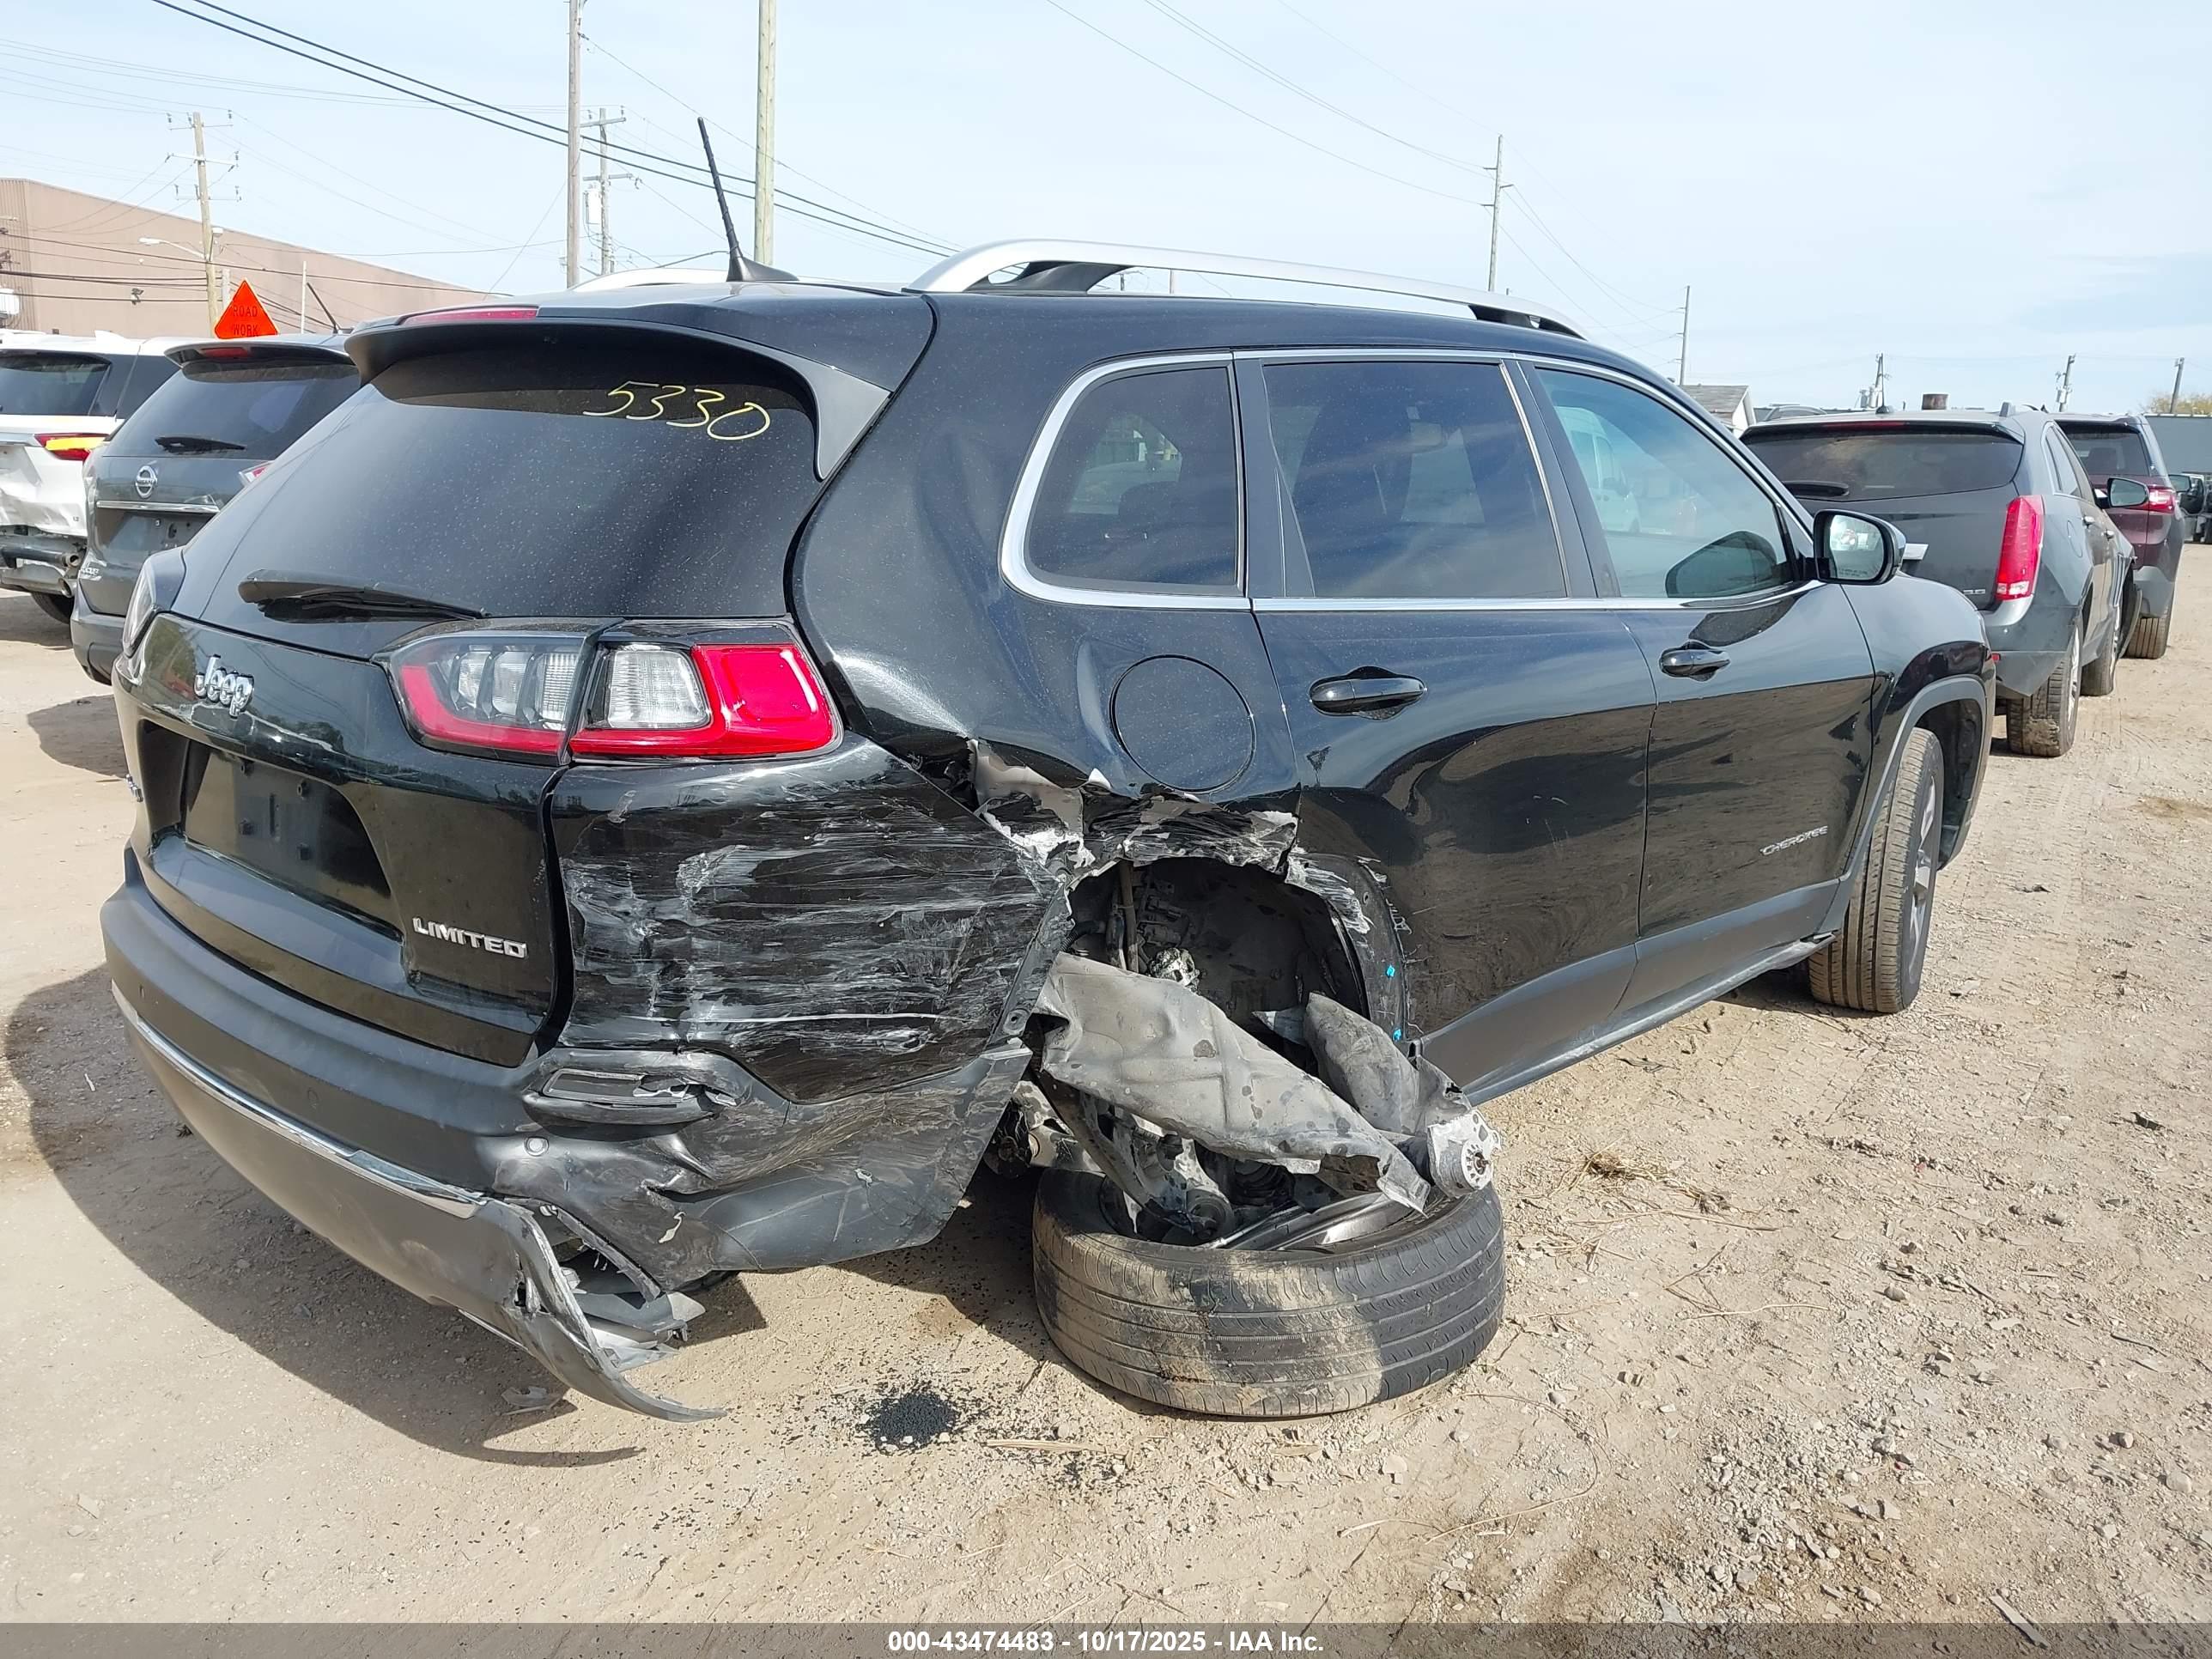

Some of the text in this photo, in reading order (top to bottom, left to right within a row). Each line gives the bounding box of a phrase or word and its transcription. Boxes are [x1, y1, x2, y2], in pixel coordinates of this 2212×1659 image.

[233, 305, 258, 317] ROAD
[233, 324, 258, 337] WORK
[582, 380, 771, 441] 5330
[194, 654, 254, 719] Jeep
[1759, 825, 1828, 855] CHEROKEE
[412, 916, 528, 959] LIMITED
